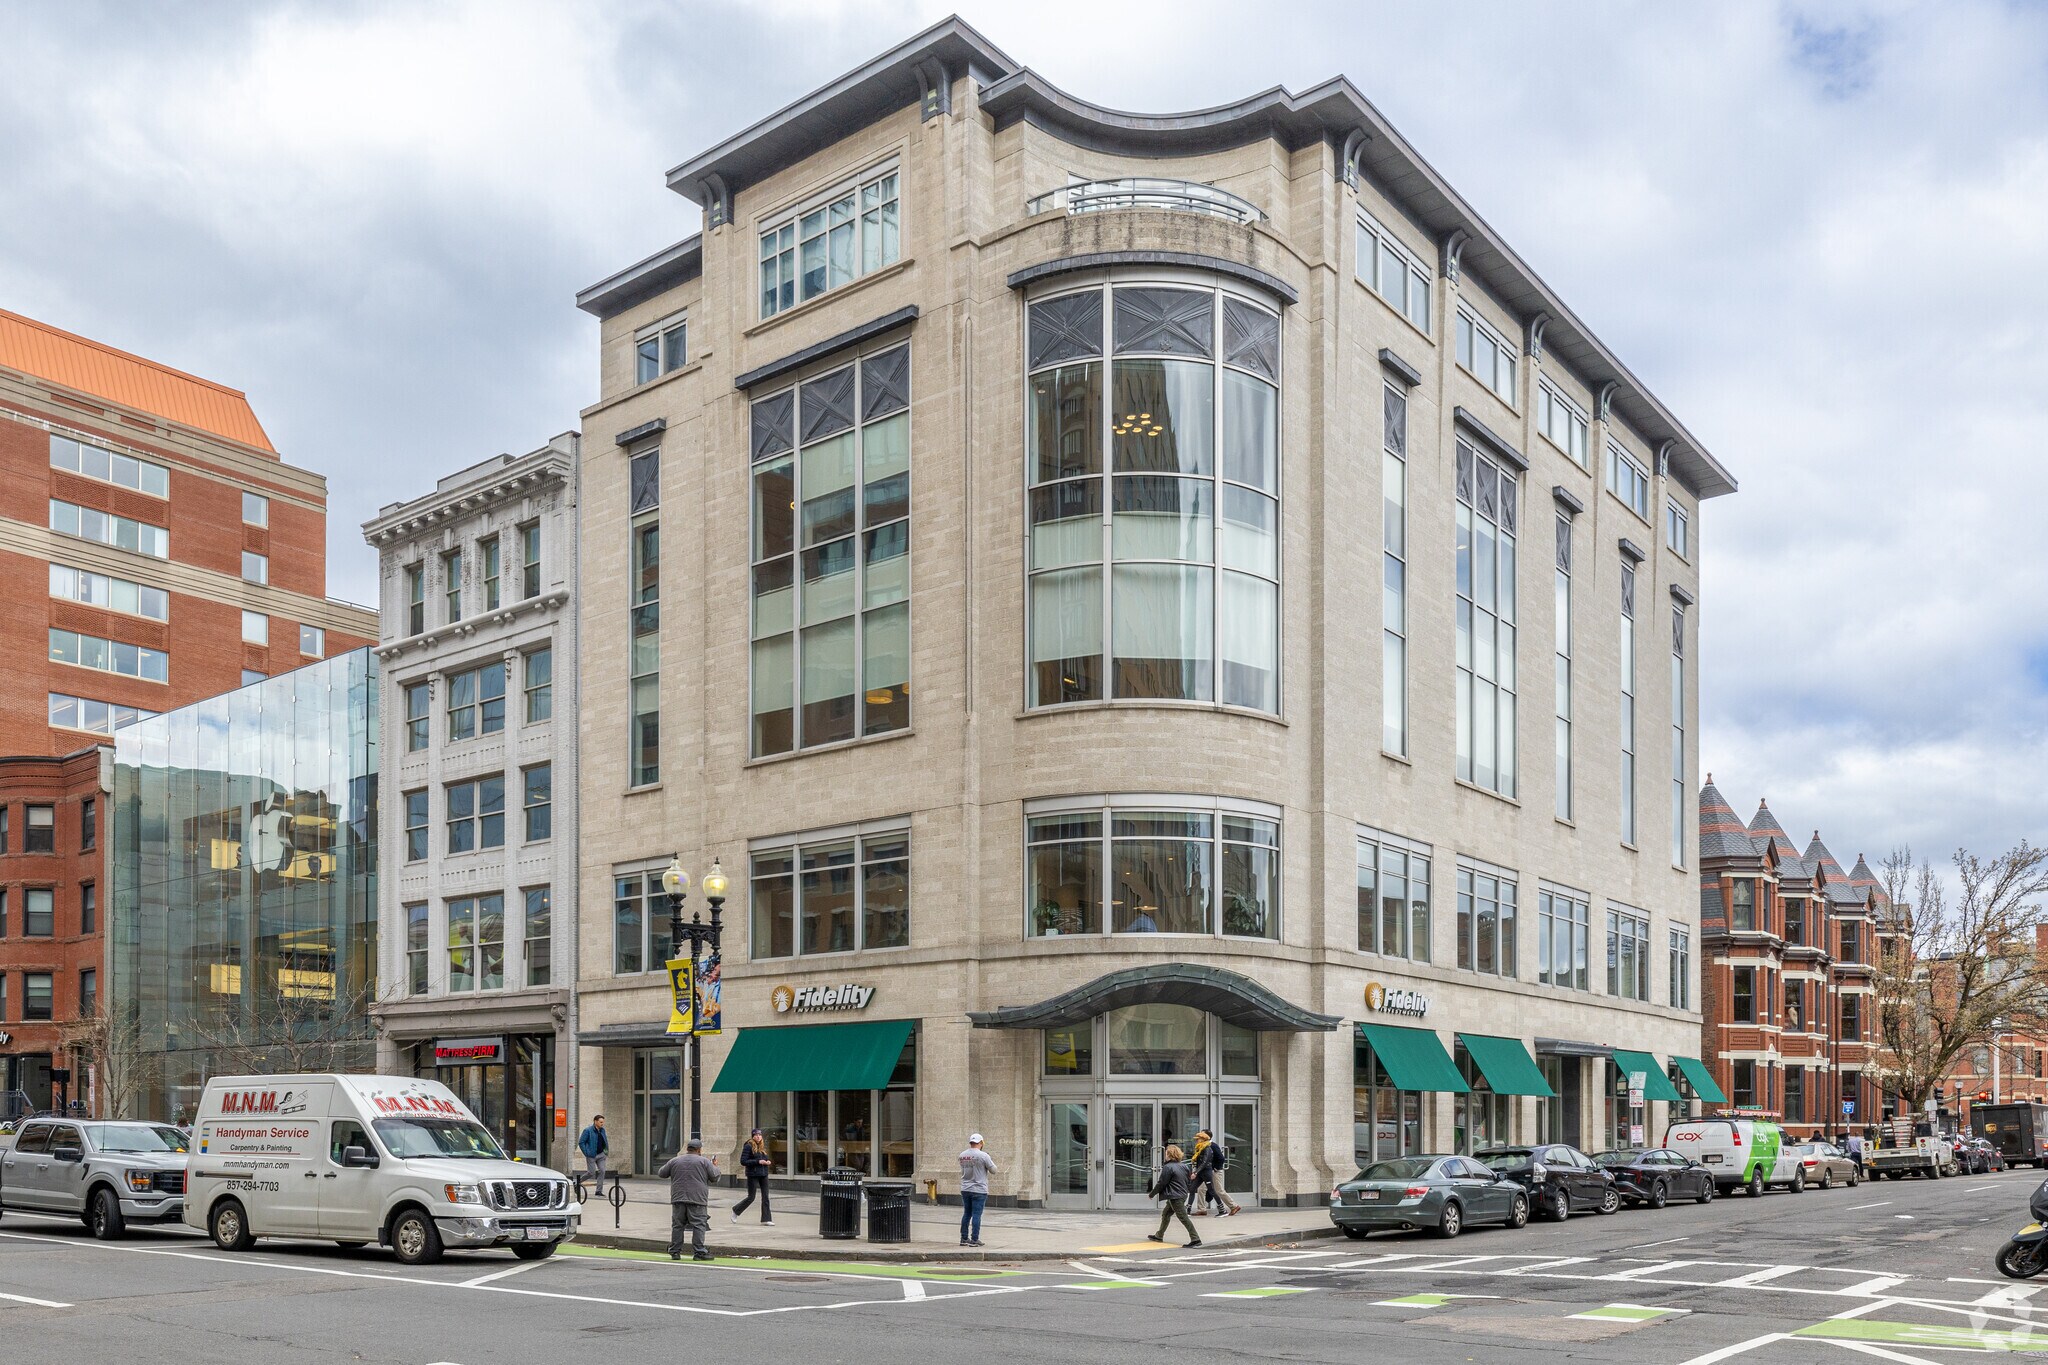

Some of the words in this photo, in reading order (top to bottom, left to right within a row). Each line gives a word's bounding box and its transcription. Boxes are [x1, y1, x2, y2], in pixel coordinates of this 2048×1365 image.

[792, 984, 875, 1009] Fidelity
[1383, 987, 1431, 1016] Fidelity
[793, 1005, 857, 1013] INVESTMENTS
[221, 1091, 279, 1114] M.N.M.
[373, 1096, 465, 1116] M.N.M.
[216, 1127, 270, 1140] Handyman
[270, 1127, 309, 1138] Service
[1676, 1130, 1704, 1142] COX
[230, 1144, 260, 1152] Carpentry
[266, 1144, 292, 1153] Painting
[223, 1160, 289, 1169] mnmhandyman.com
[226, 1180, 279, 1192] 857-294-7703
